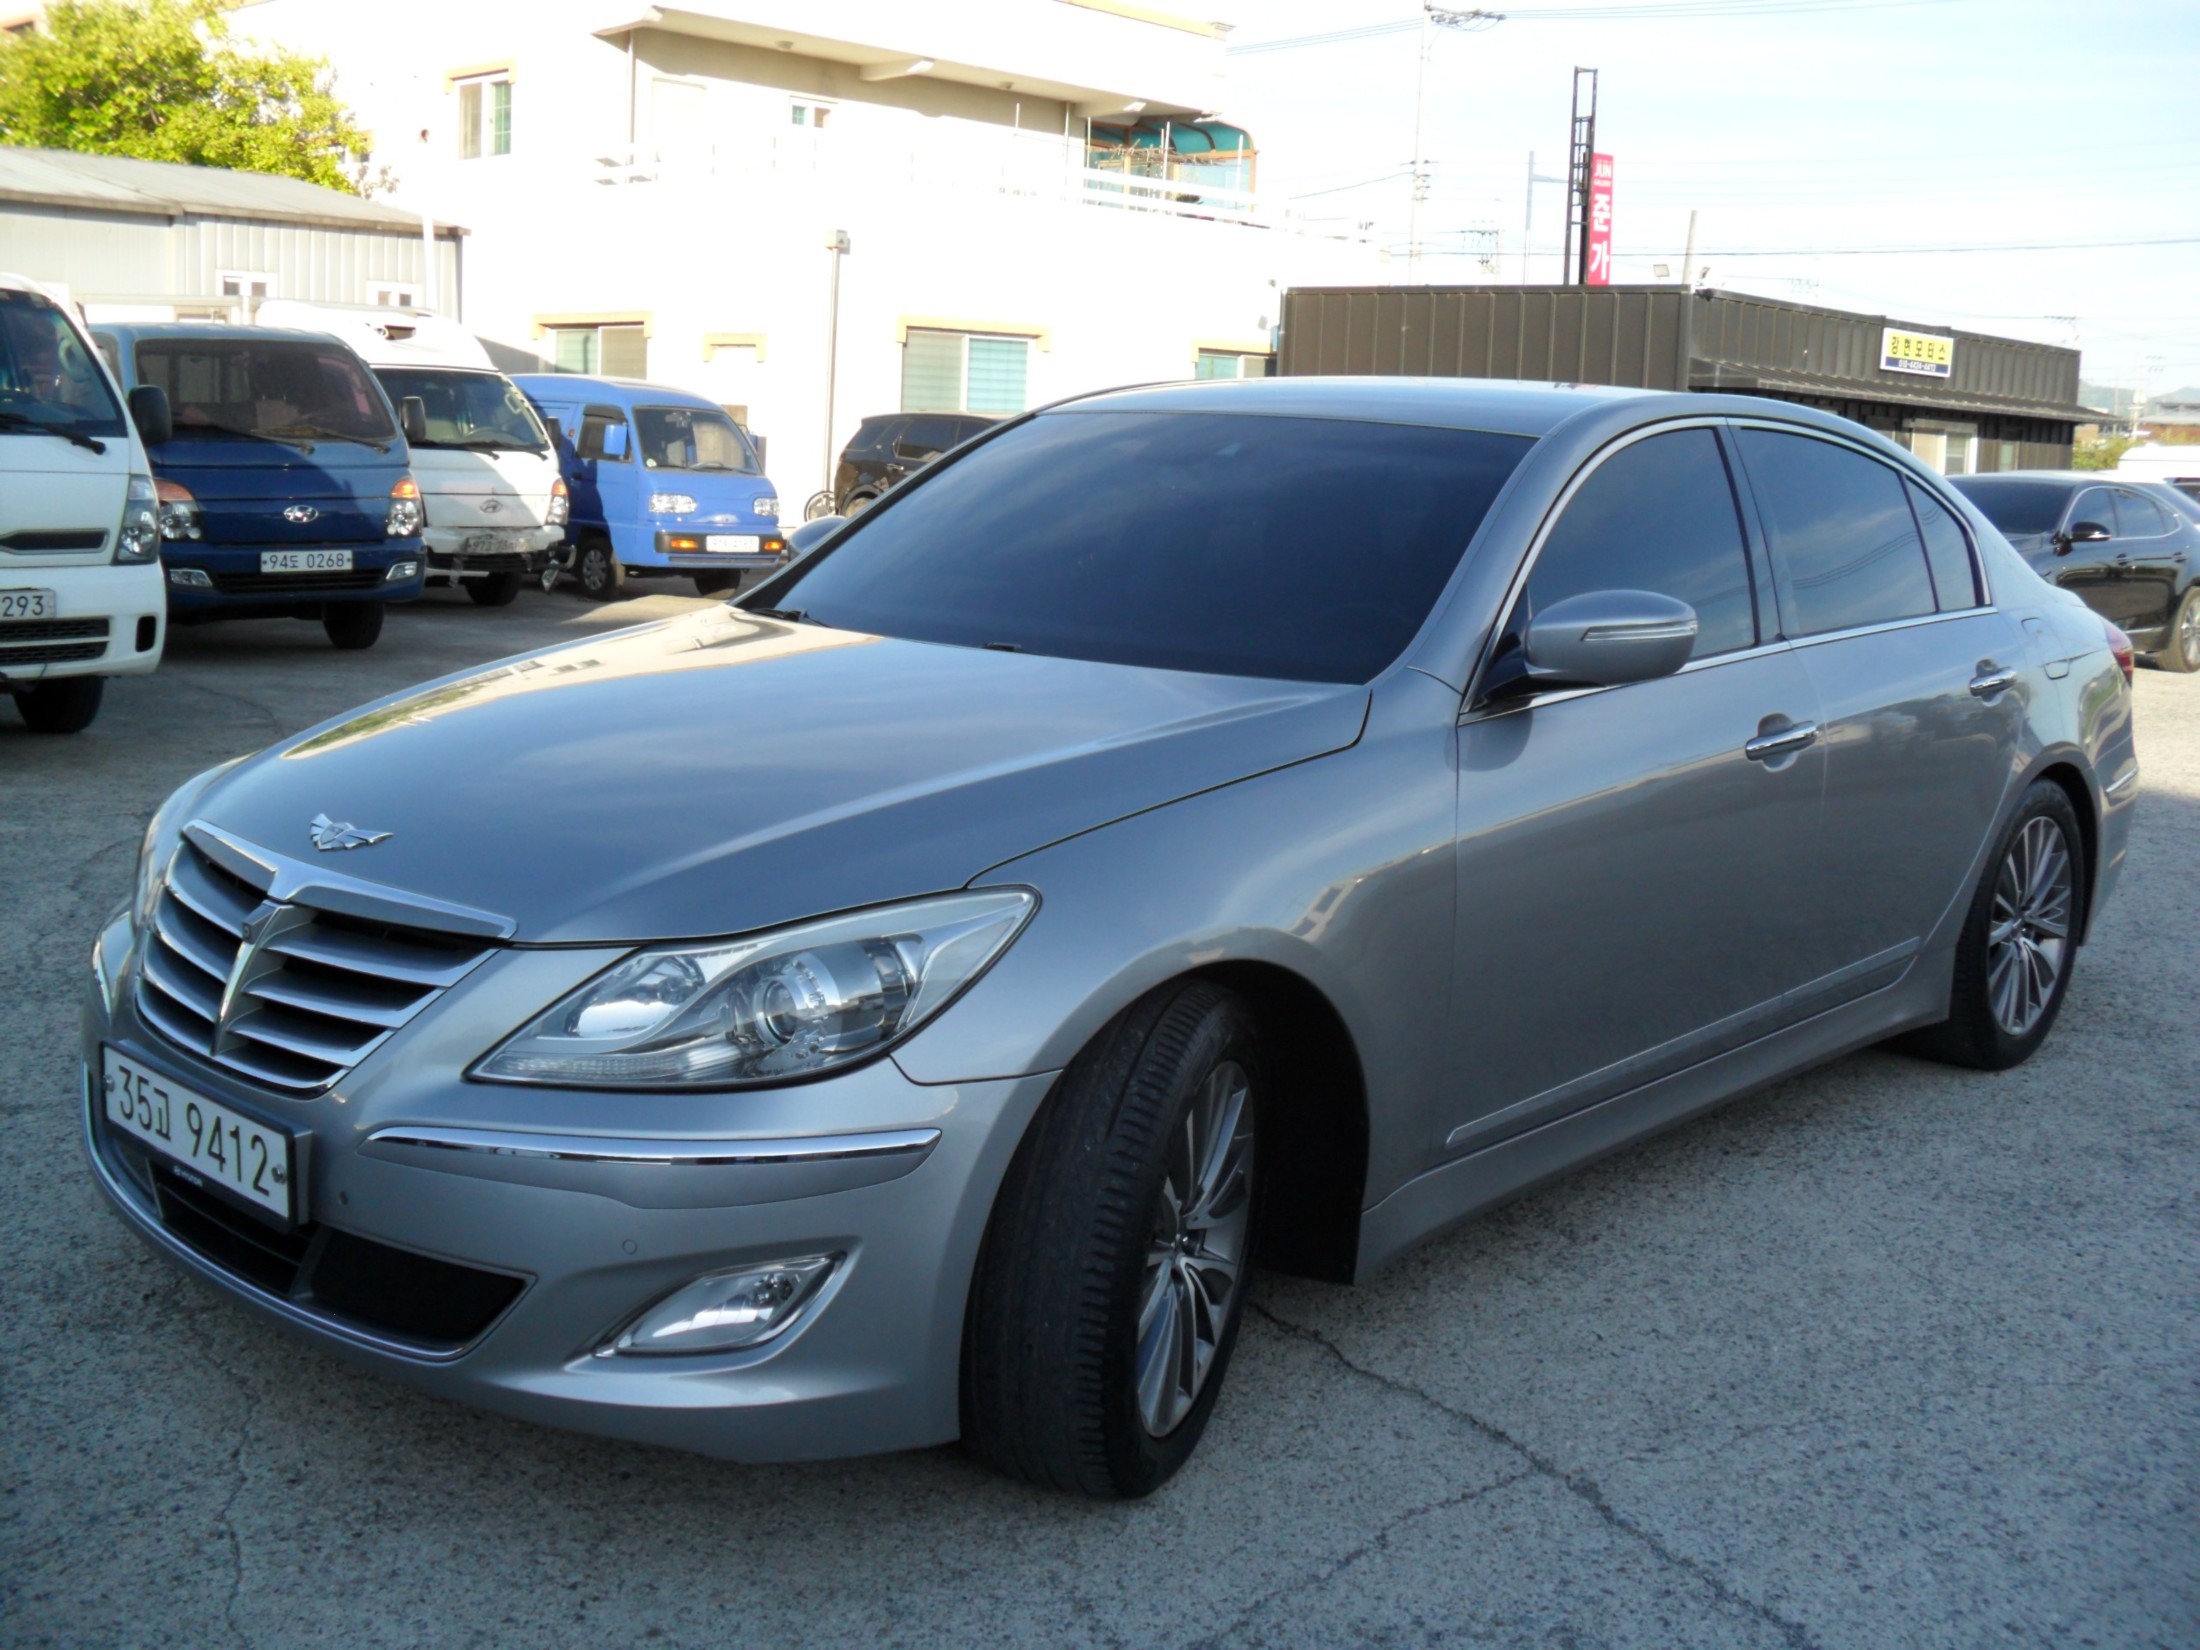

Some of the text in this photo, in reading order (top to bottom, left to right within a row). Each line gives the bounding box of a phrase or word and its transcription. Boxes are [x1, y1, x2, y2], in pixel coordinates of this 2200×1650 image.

[1594, 162, 1612, 179] JUN
[306, 553, 344, 568] 0268
[2, 595, 44, 617] 293
[118, 1064, 270, 1197] 35고 9412
